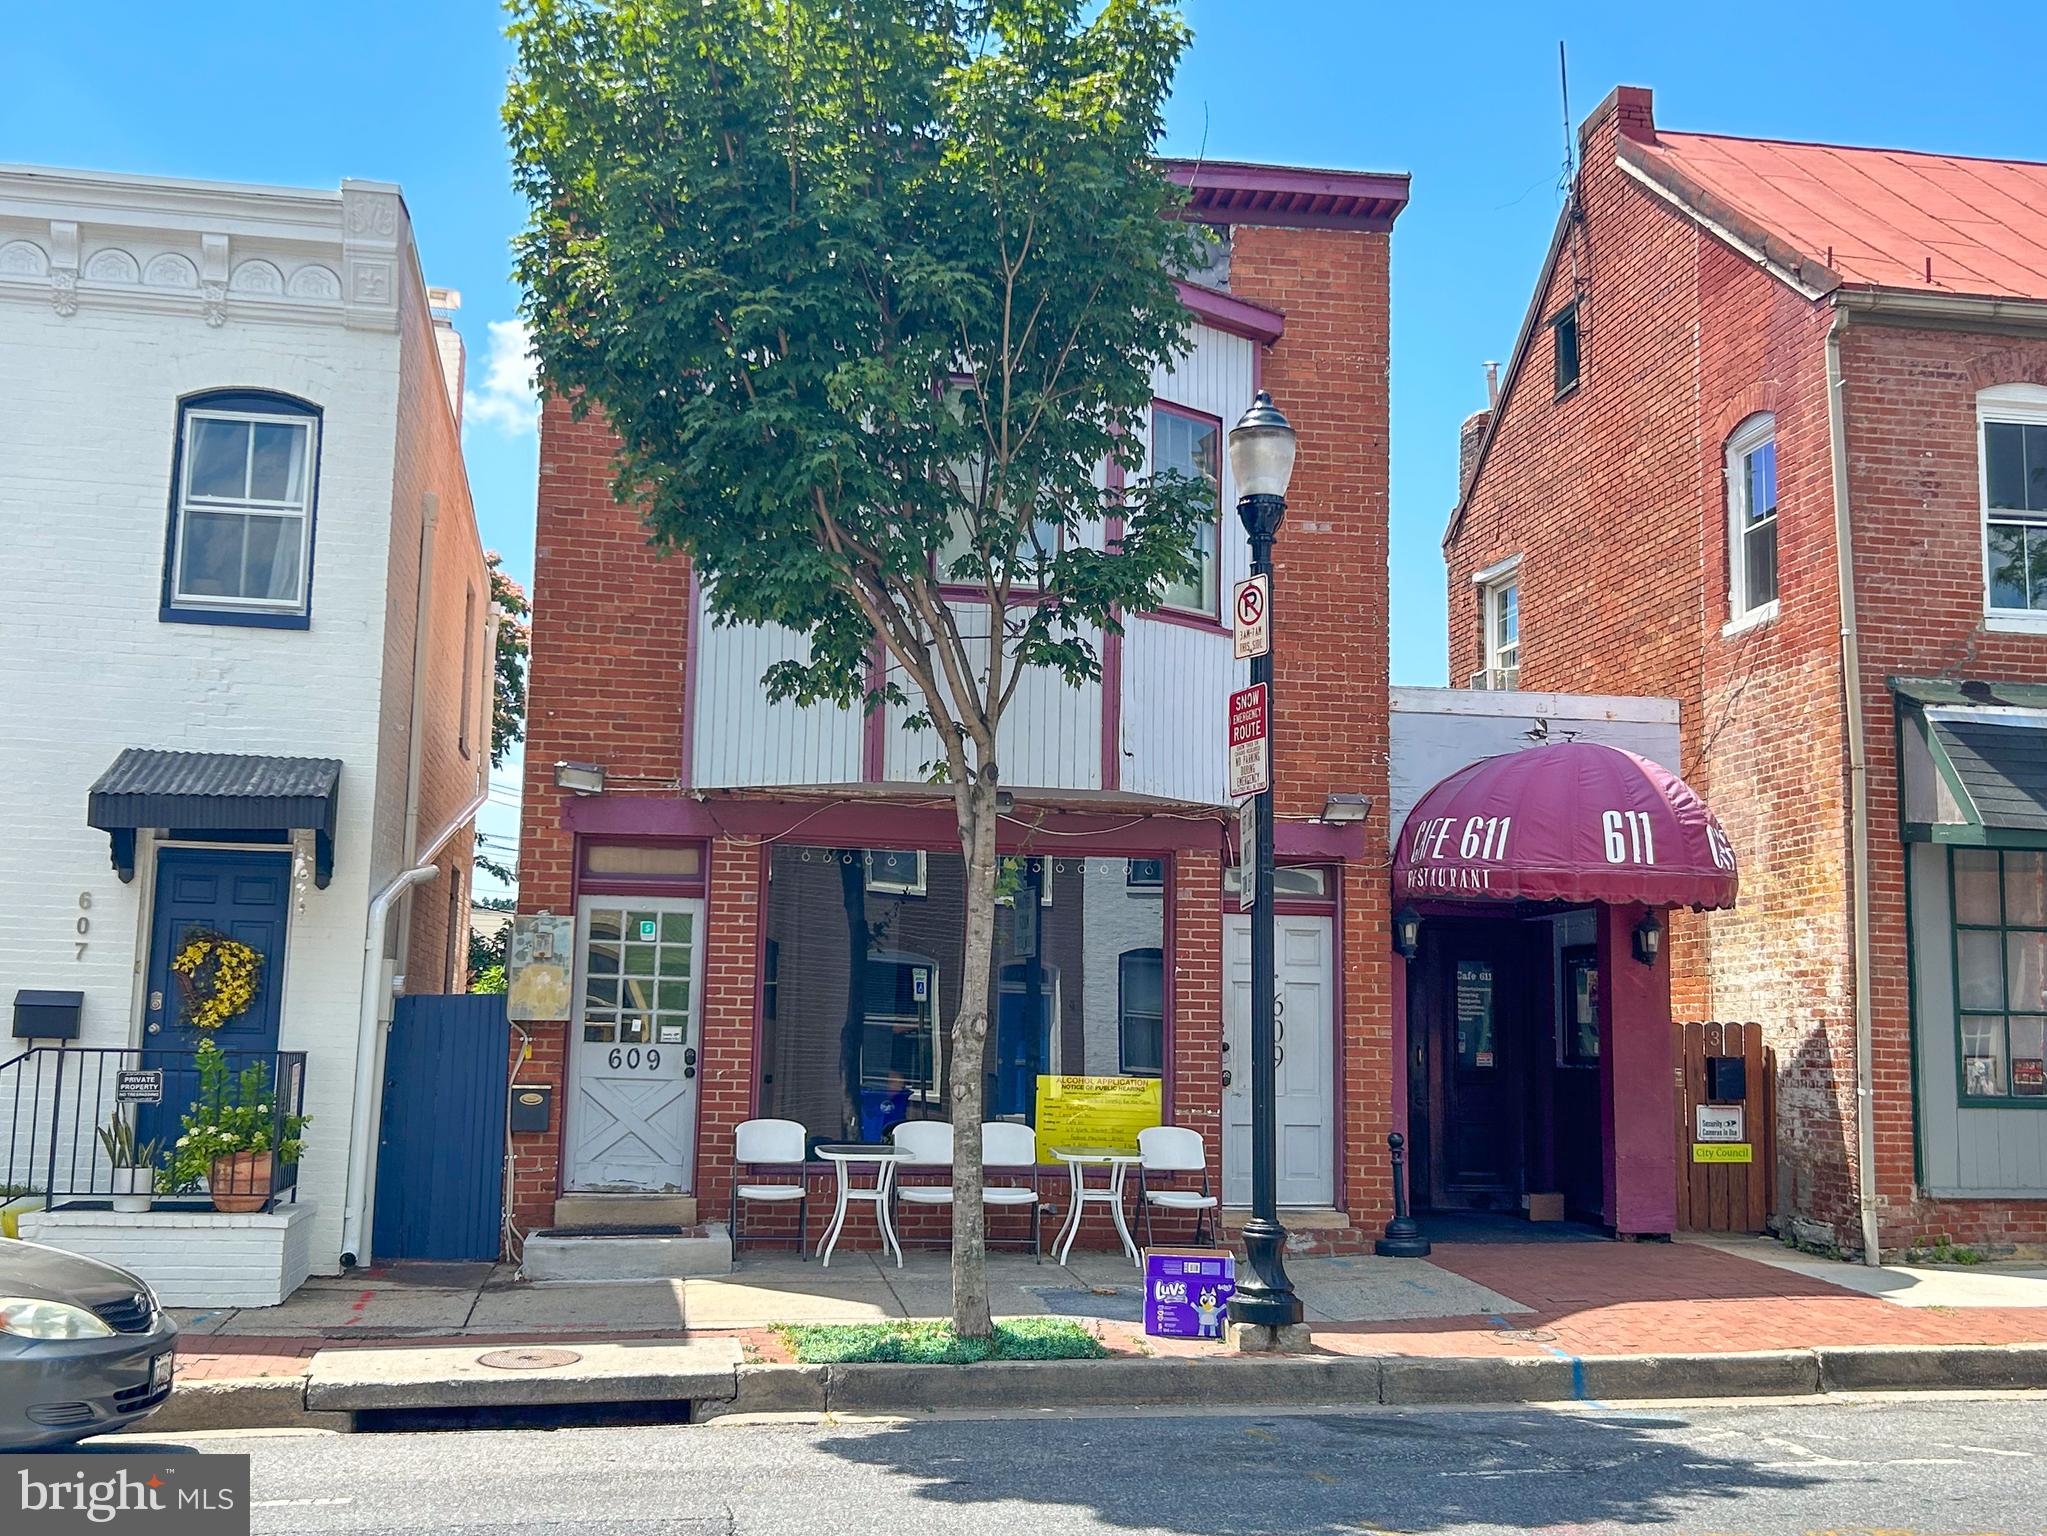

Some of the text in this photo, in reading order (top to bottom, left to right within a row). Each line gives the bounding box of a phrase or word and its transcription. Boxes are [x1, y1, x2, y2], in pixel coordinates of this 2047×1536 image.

[1235, 690, 1260, 712] SNOW
[1233, 706, 1262, 725] EMERGENCY
[1233, 720, 1262, 742] ROUTE
[1235, 752, 1261, 767] NO PARKING
[1240, 763, 1256, 776] DURING
[1236, 773, 1261, 788] EMERGENCY
[1410, 815, 1512, 863] CAFE 611
[1601, 810, 1655, 865] 611
[1407, 867, 1491, 889] RESTAURANT
[1457, 970, 1492, 981] Cafe 611
[1710, 1030, 1720, 1046] 3
[608, 1047, 661, 1071] 609
[1056, 1077, 1149, 1087] ALCOHOL APPLICATION
[1702, 1119, 1722, 1129] Security
[1702, 1128, 1722, 1136] Cameras
[1696, 1147, 1749, 1158] City Council
[1155, 1280, 1187, 1300] Luvs
